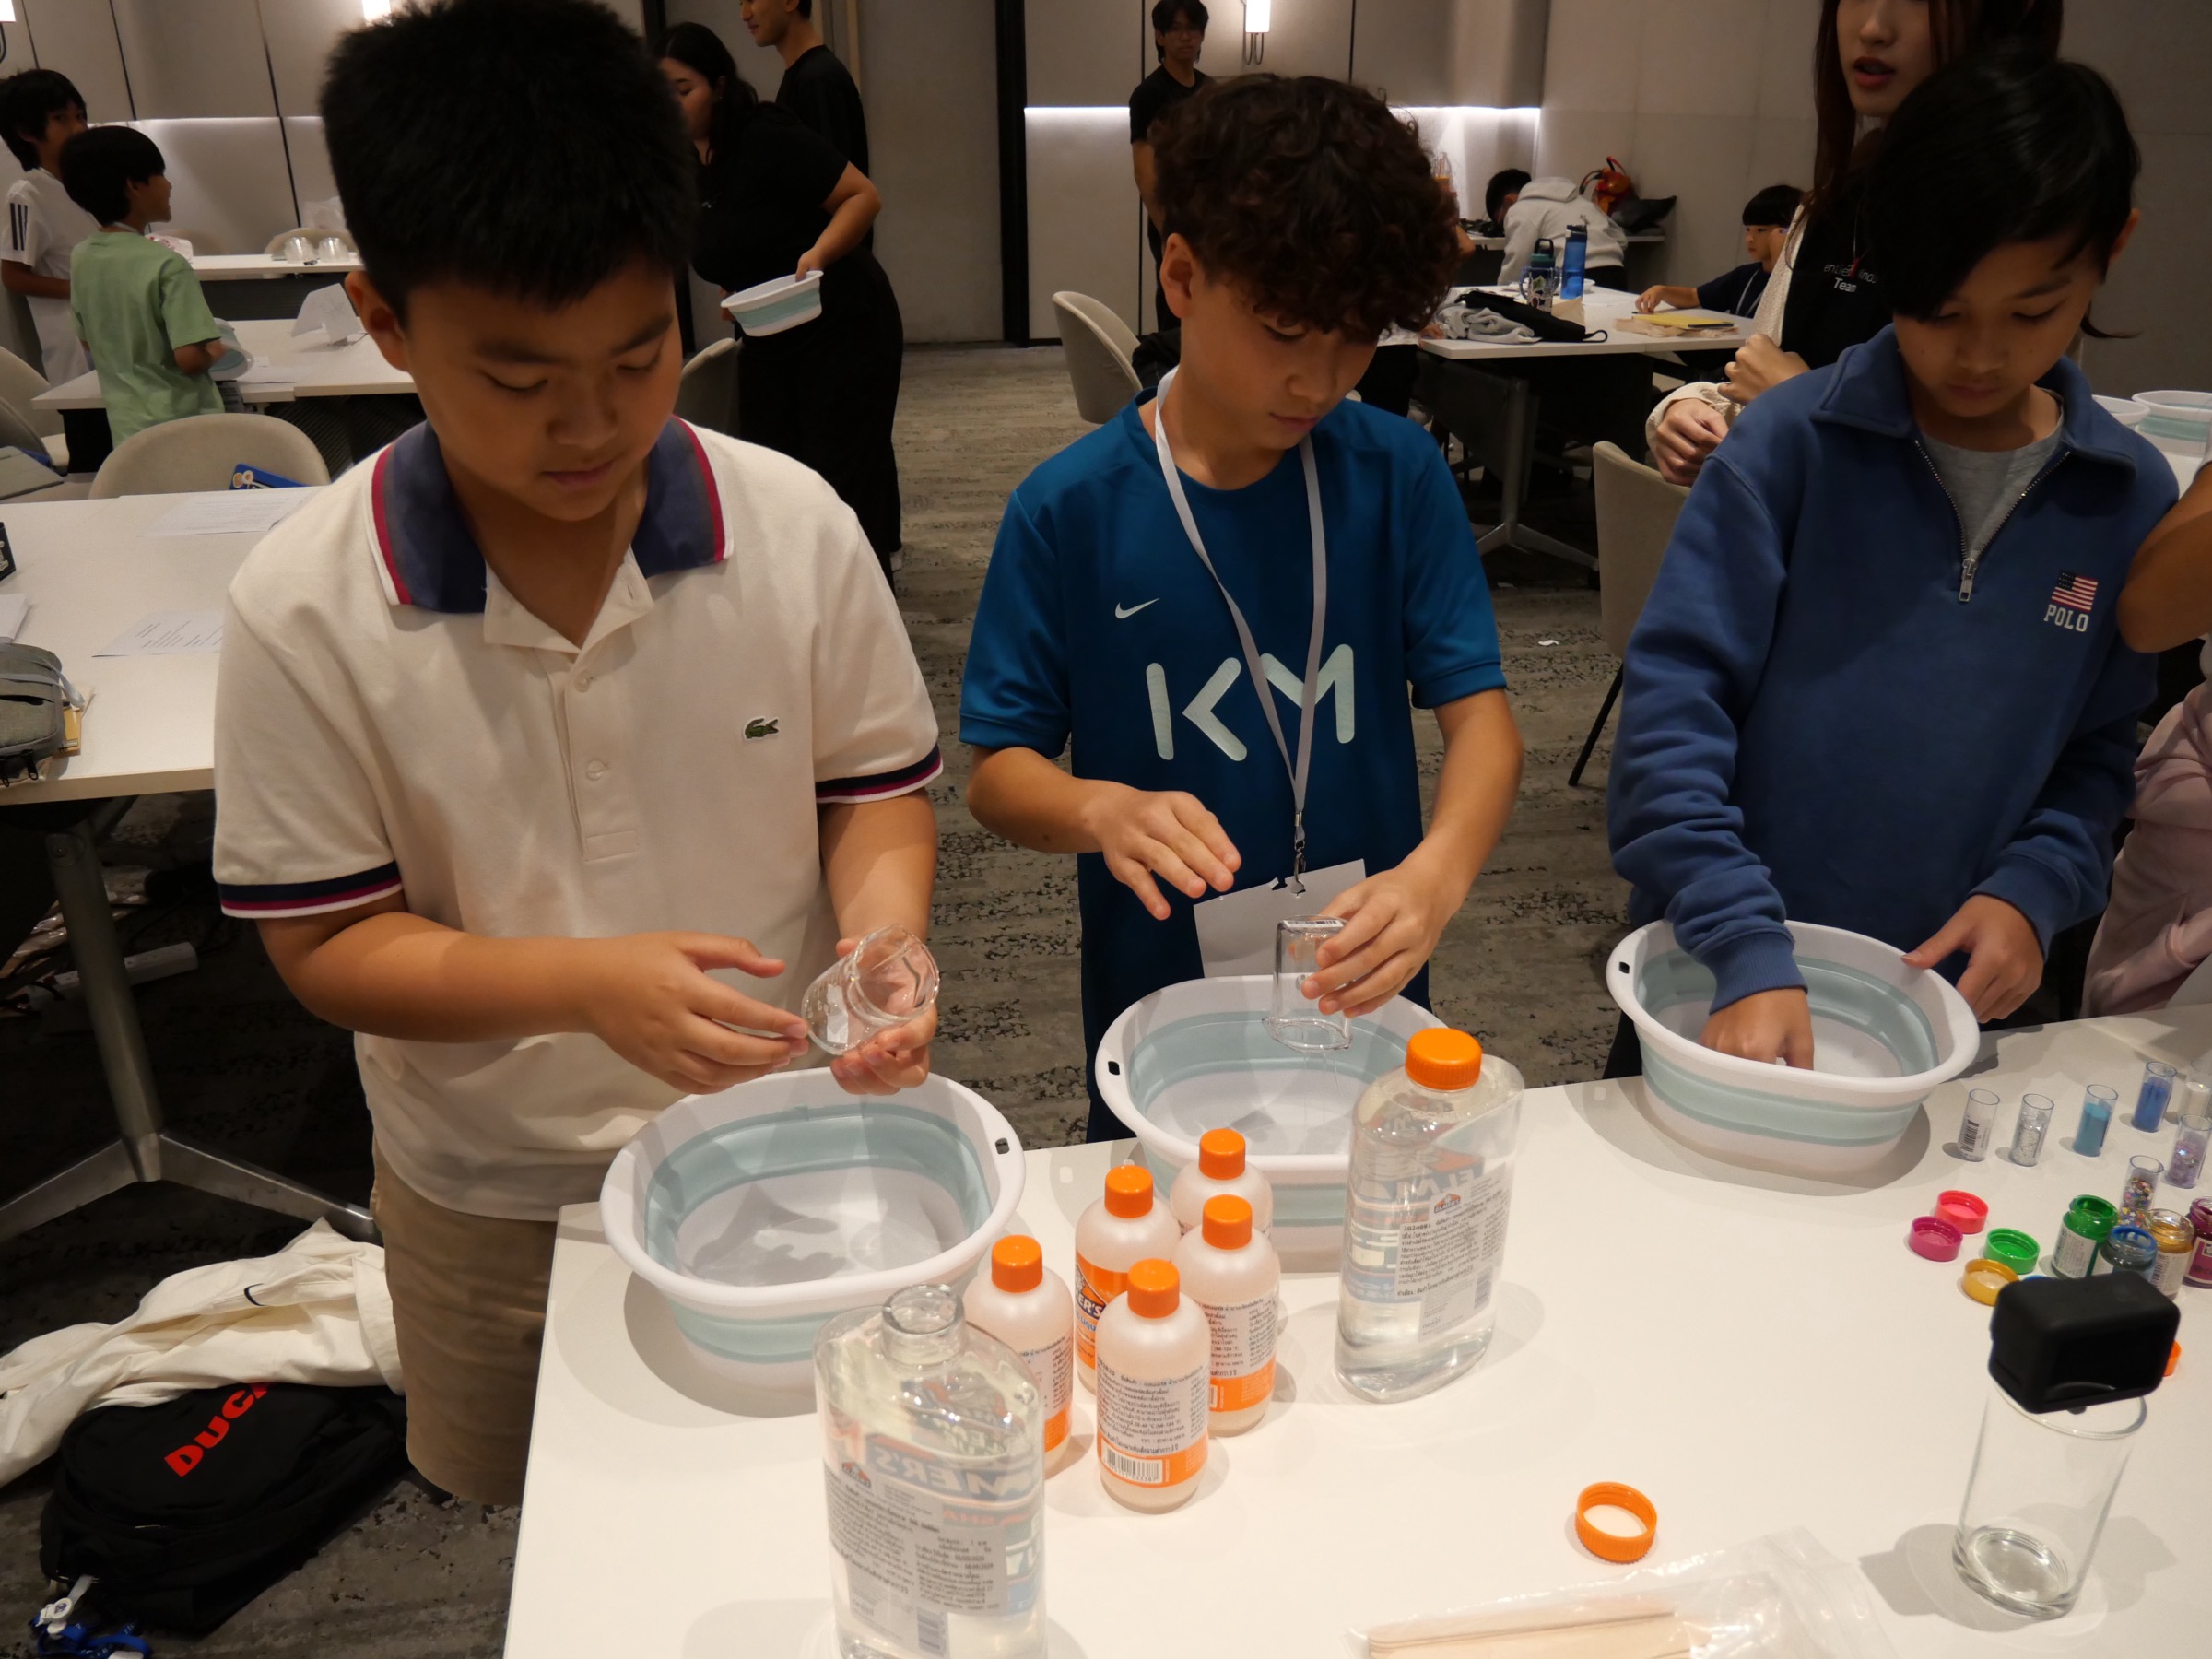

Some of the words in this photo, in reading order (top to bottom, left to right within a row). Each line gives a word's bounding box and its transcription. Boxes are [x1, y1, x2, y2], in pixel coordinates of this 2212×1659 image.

[2043, 604, 2089, 632] POLO
[1146, 643, 1355, 761] KM
[1076, 1292, 1104, 1318] ER'S
[1080, 1315, 1096, 1332] LIQU
